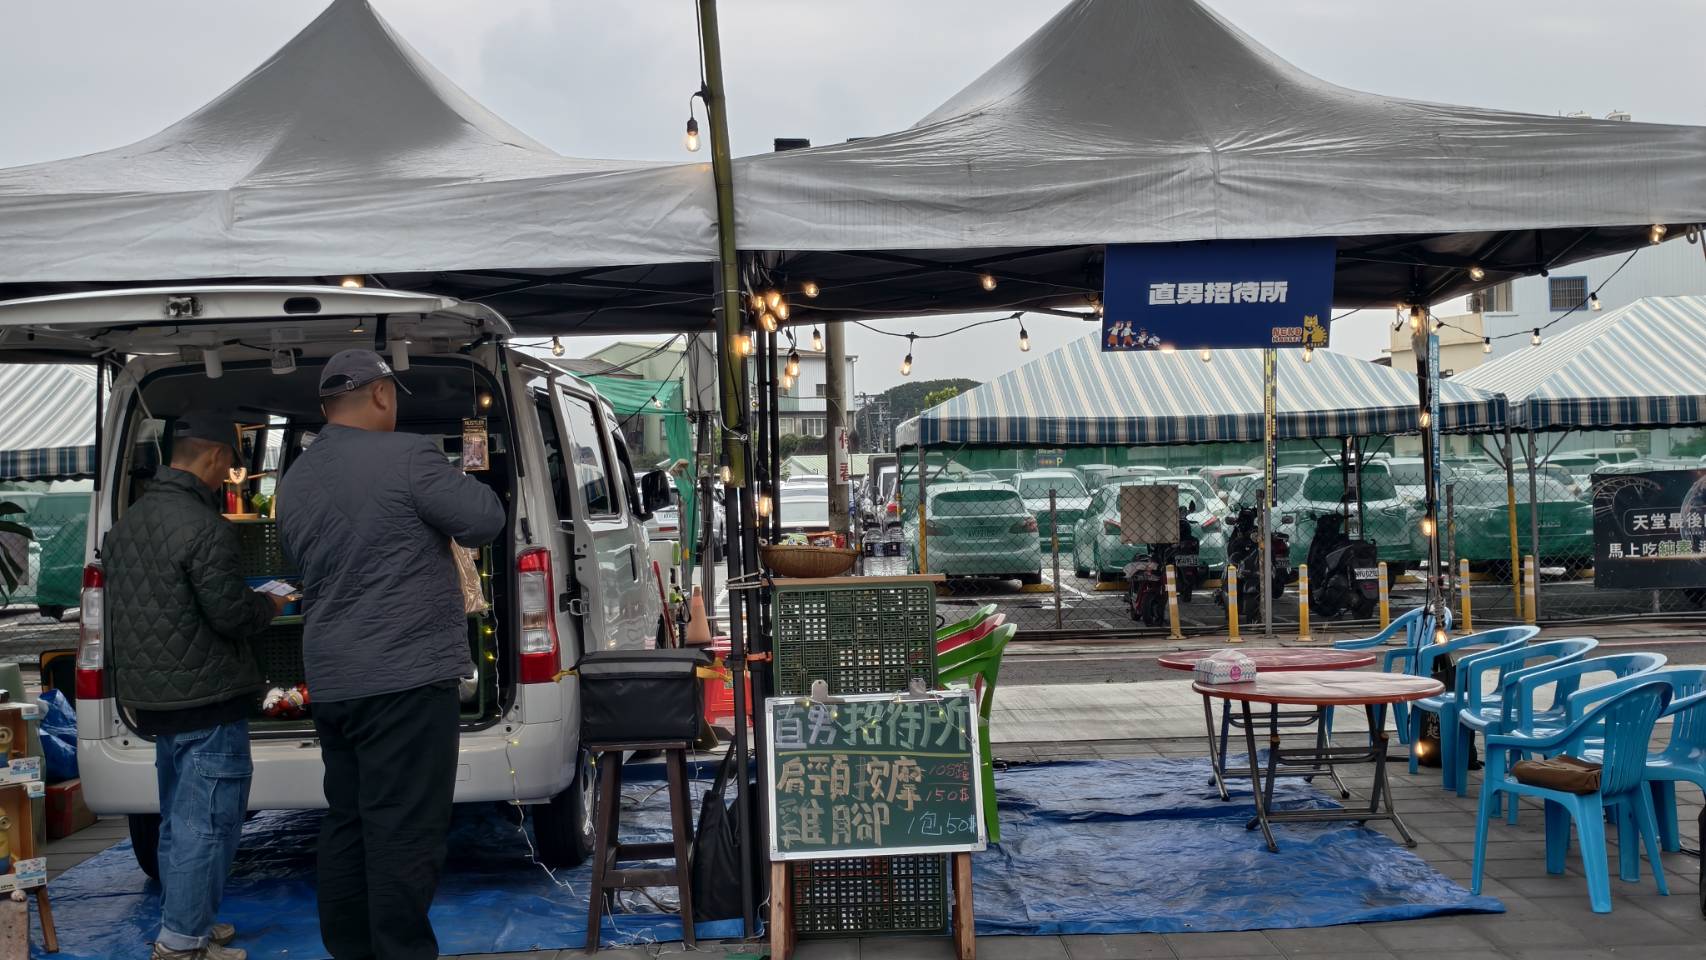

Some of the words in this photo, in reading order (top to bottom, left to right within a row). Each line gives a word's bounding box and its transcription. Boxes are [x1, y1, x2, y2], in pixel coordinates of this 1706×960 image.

[1149, 281, 1288, 305] 直男招待所
[1633, 512, 1706, 531] 天堂最後
[775, 698, 969, 750] 直男招待所
[776, 754, 924, 812] 肩頸按摩
[926, 786, 970, 802] 150$
[779, 798, 890, 849] 雞腳
